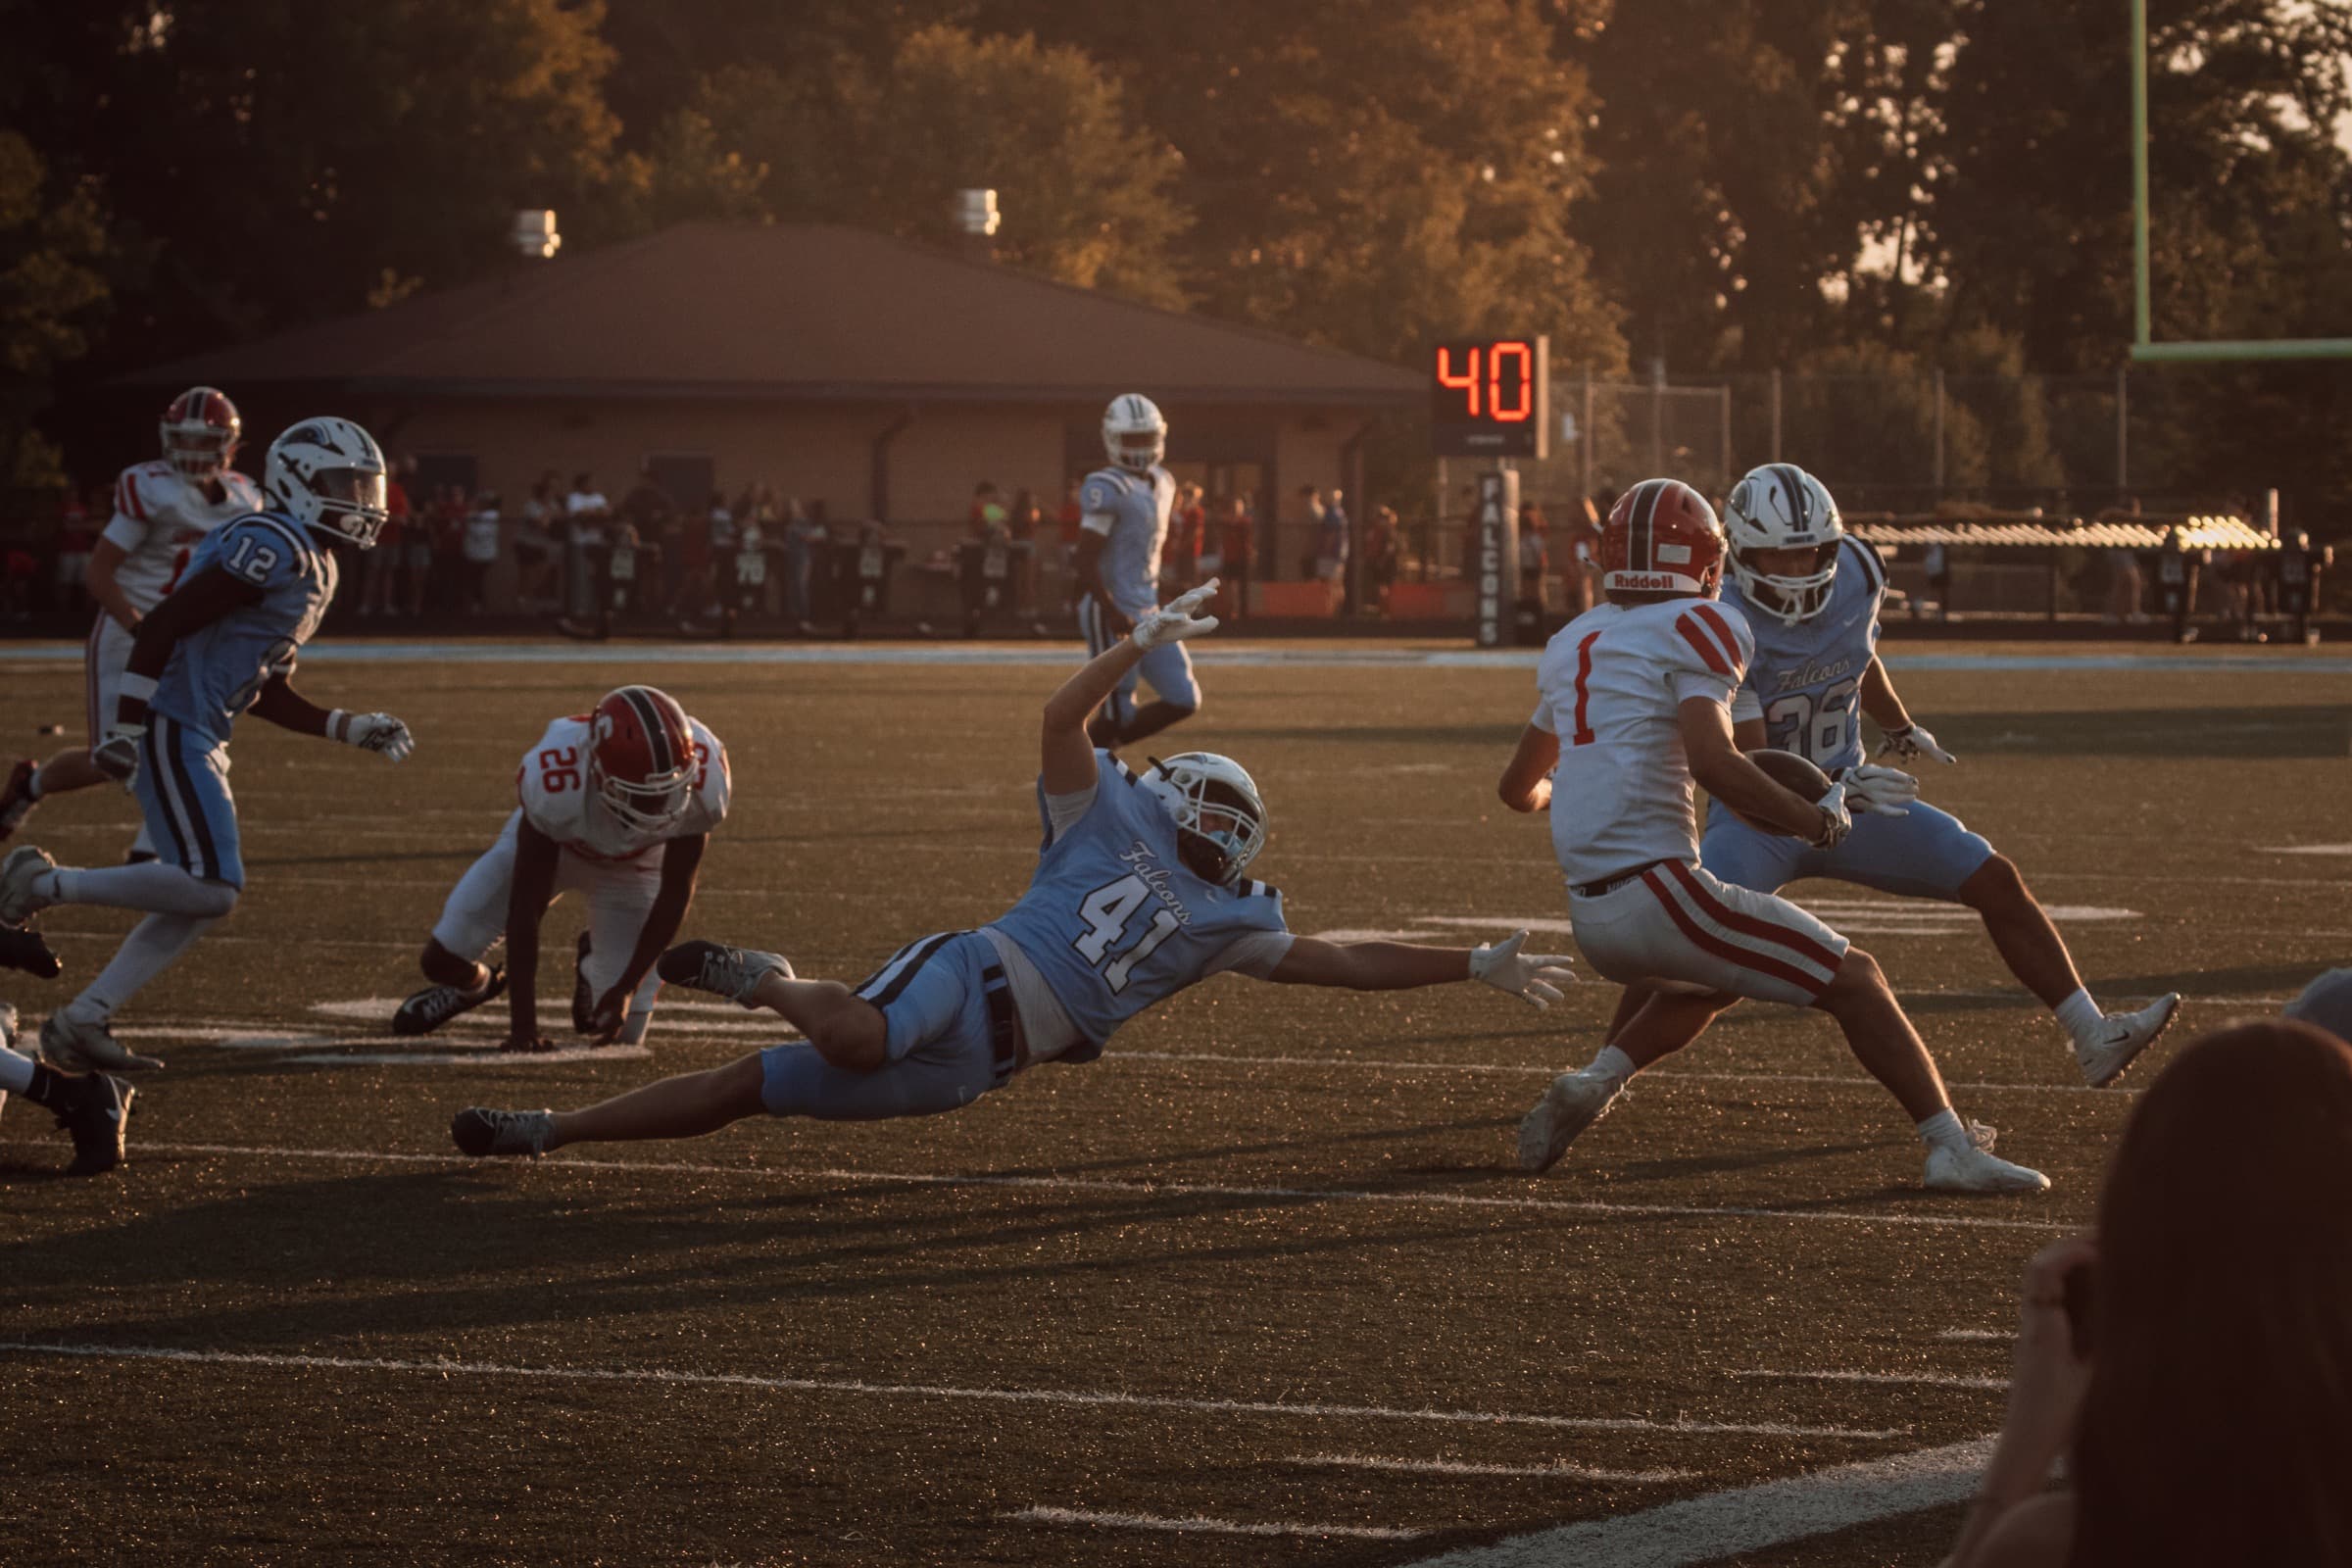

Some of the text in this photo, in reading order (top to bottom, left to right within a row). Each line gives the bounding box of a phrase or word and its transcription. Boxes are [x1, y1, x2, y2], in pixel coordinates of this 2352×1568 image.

[1437, 341, 1532, 422] 40
[229, 537, 277, 582] 12
[1614, 573, 1674, 589] Riddell
[1574, 630, 1602, 746] 1
[1775, 658, 1851, 693] Falcons
[1765, 675, 1858, 766] 36
[540, 737, 580, 793] 26
[1119, 840, 1193, 926] Falcons
[1072, 872, 1181, 997] 41
